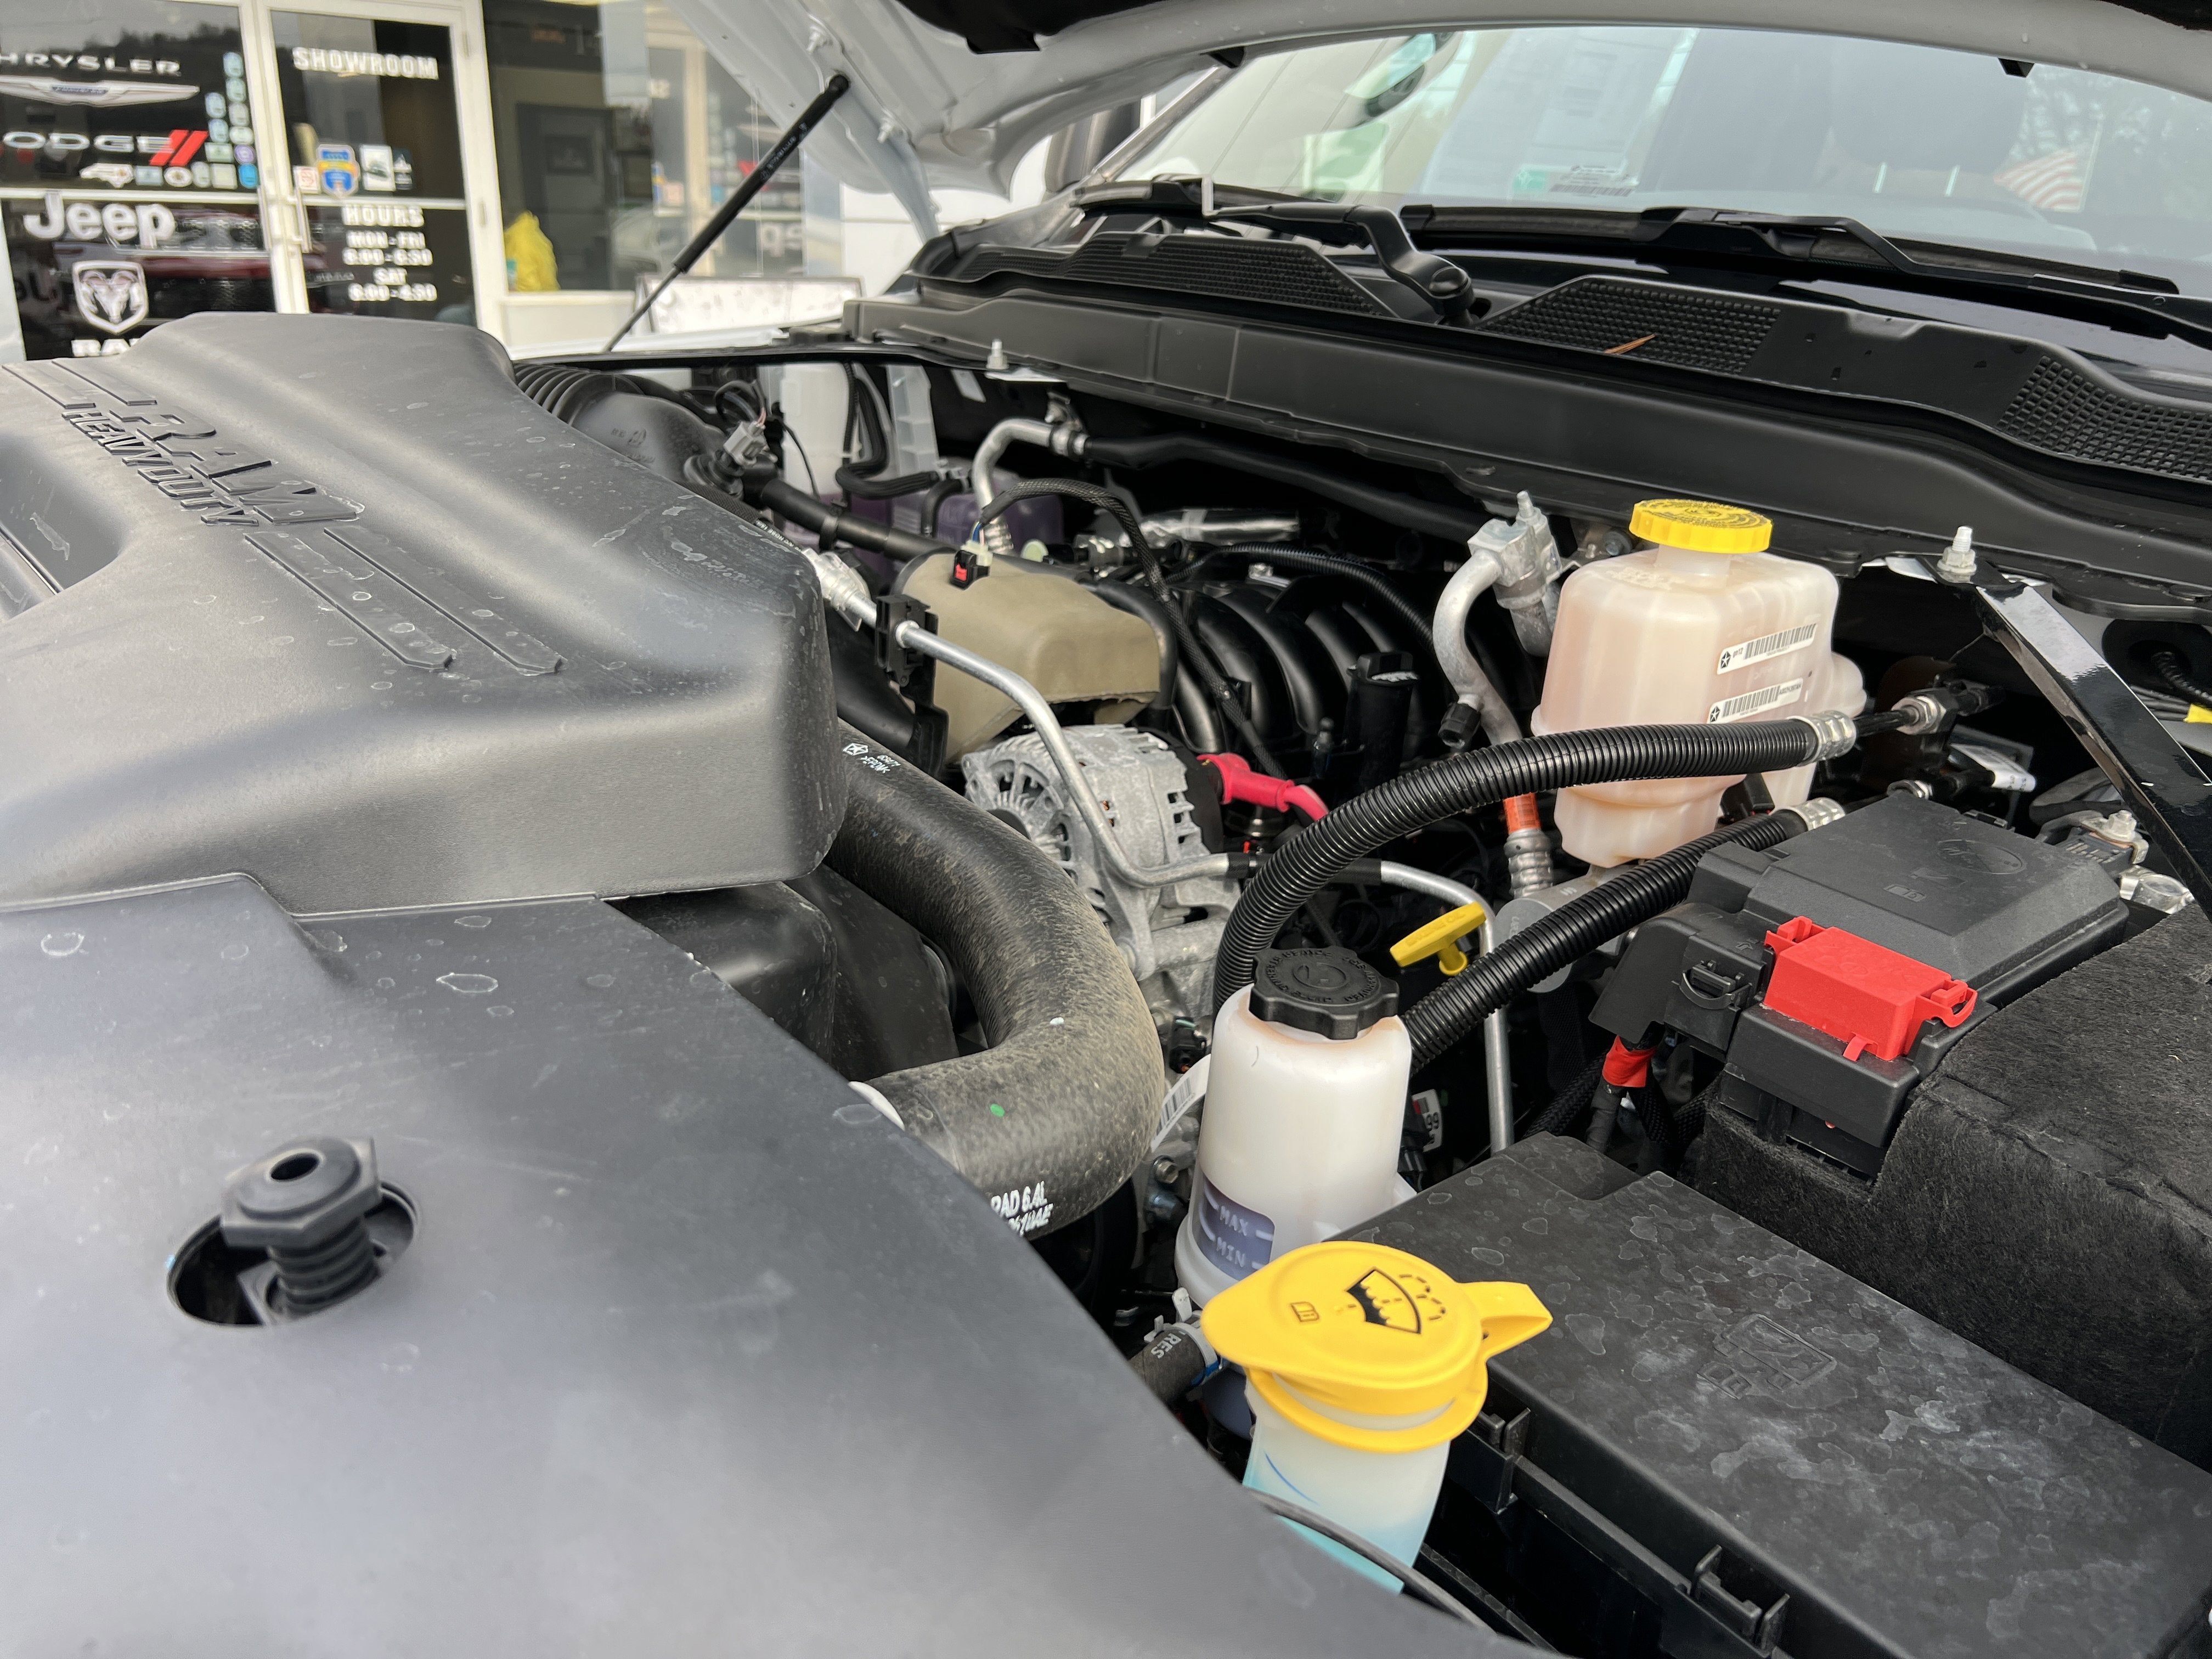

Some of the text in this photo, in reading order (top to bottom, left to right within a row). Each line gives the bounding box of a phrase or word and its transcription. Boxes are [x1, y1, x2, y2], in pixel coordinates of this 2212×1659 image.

[292, 47, 439, 80] SHOWROOM
[23, 190, 176, 250] Jeep
[342, 204, 425, 228] HOURS
[71, 338, 140, 357] RA
[61, 411, 259, 526] HEAVY DUTY
[109, 405, 358, 524] RAM
[1220, 1205, 1249, 1237] MAX
[1216, 1237, 1246, 1268] MIN
[1151, 1333, 1182, 1359] RES
